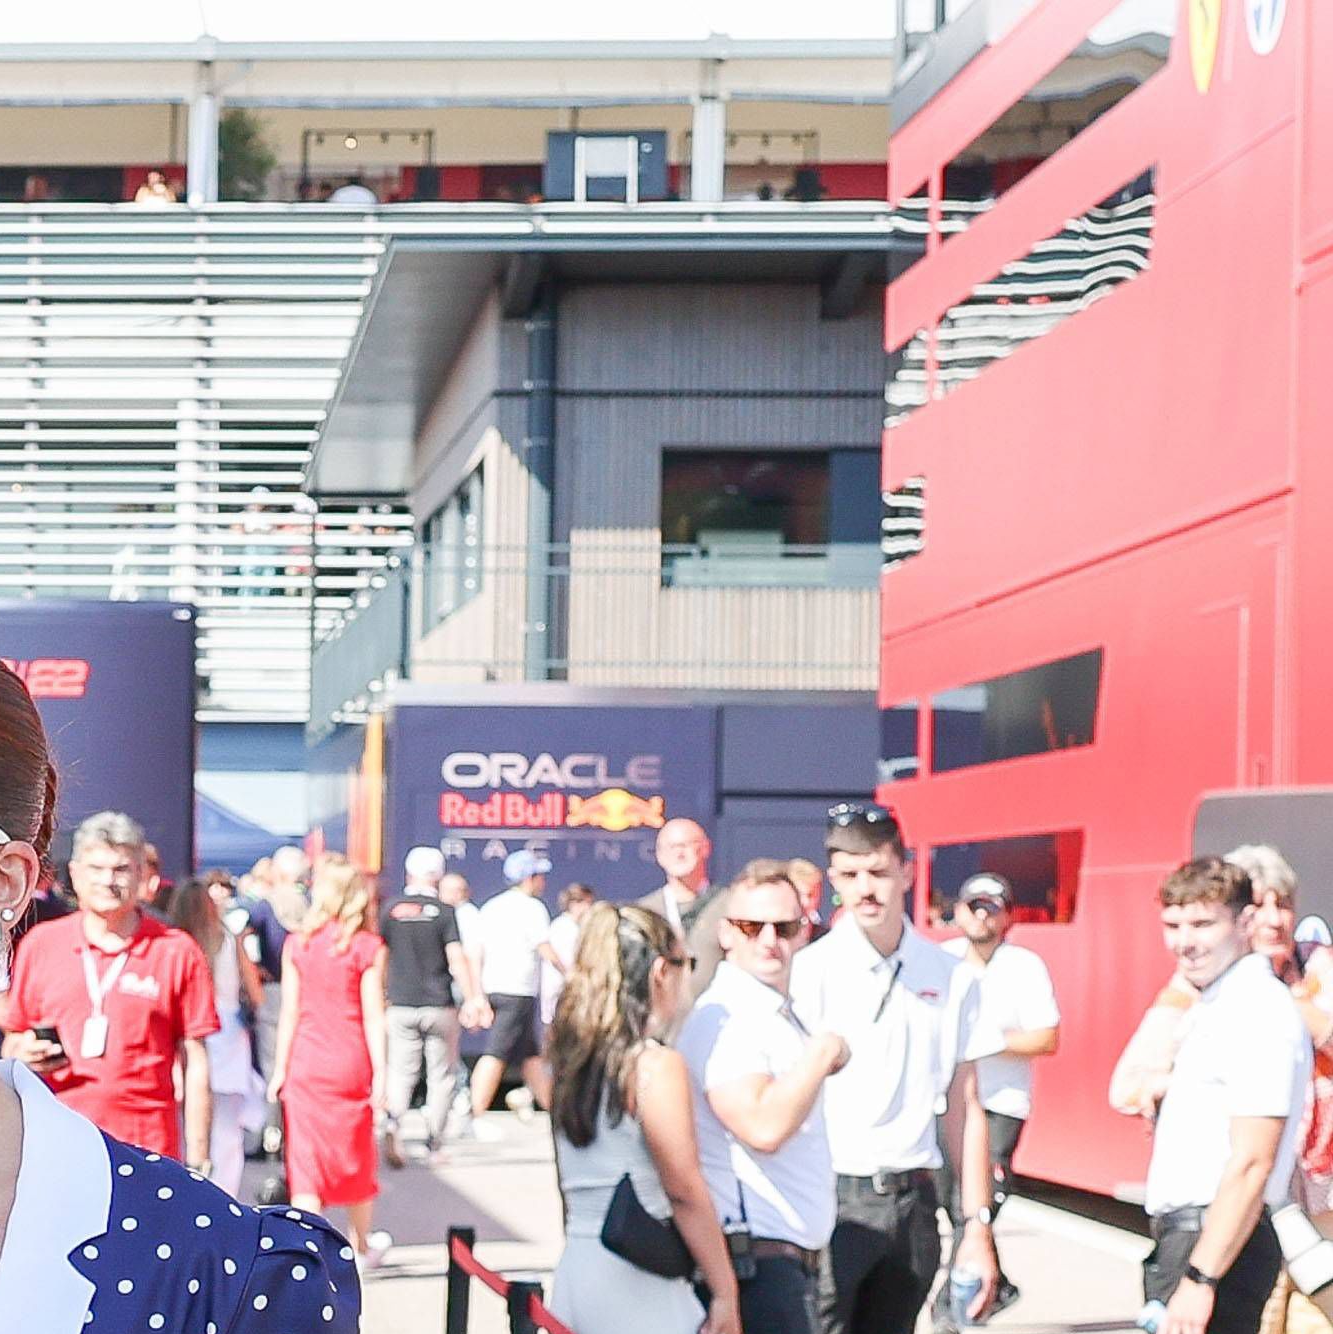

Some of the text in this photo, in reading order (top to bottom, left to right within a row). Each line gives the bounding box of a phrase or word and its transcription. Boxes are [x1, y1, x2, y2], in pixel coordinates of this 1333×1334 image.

[441, 752, 662, 788] ORACLE
[440, 791, 566, 827] Red Bull
